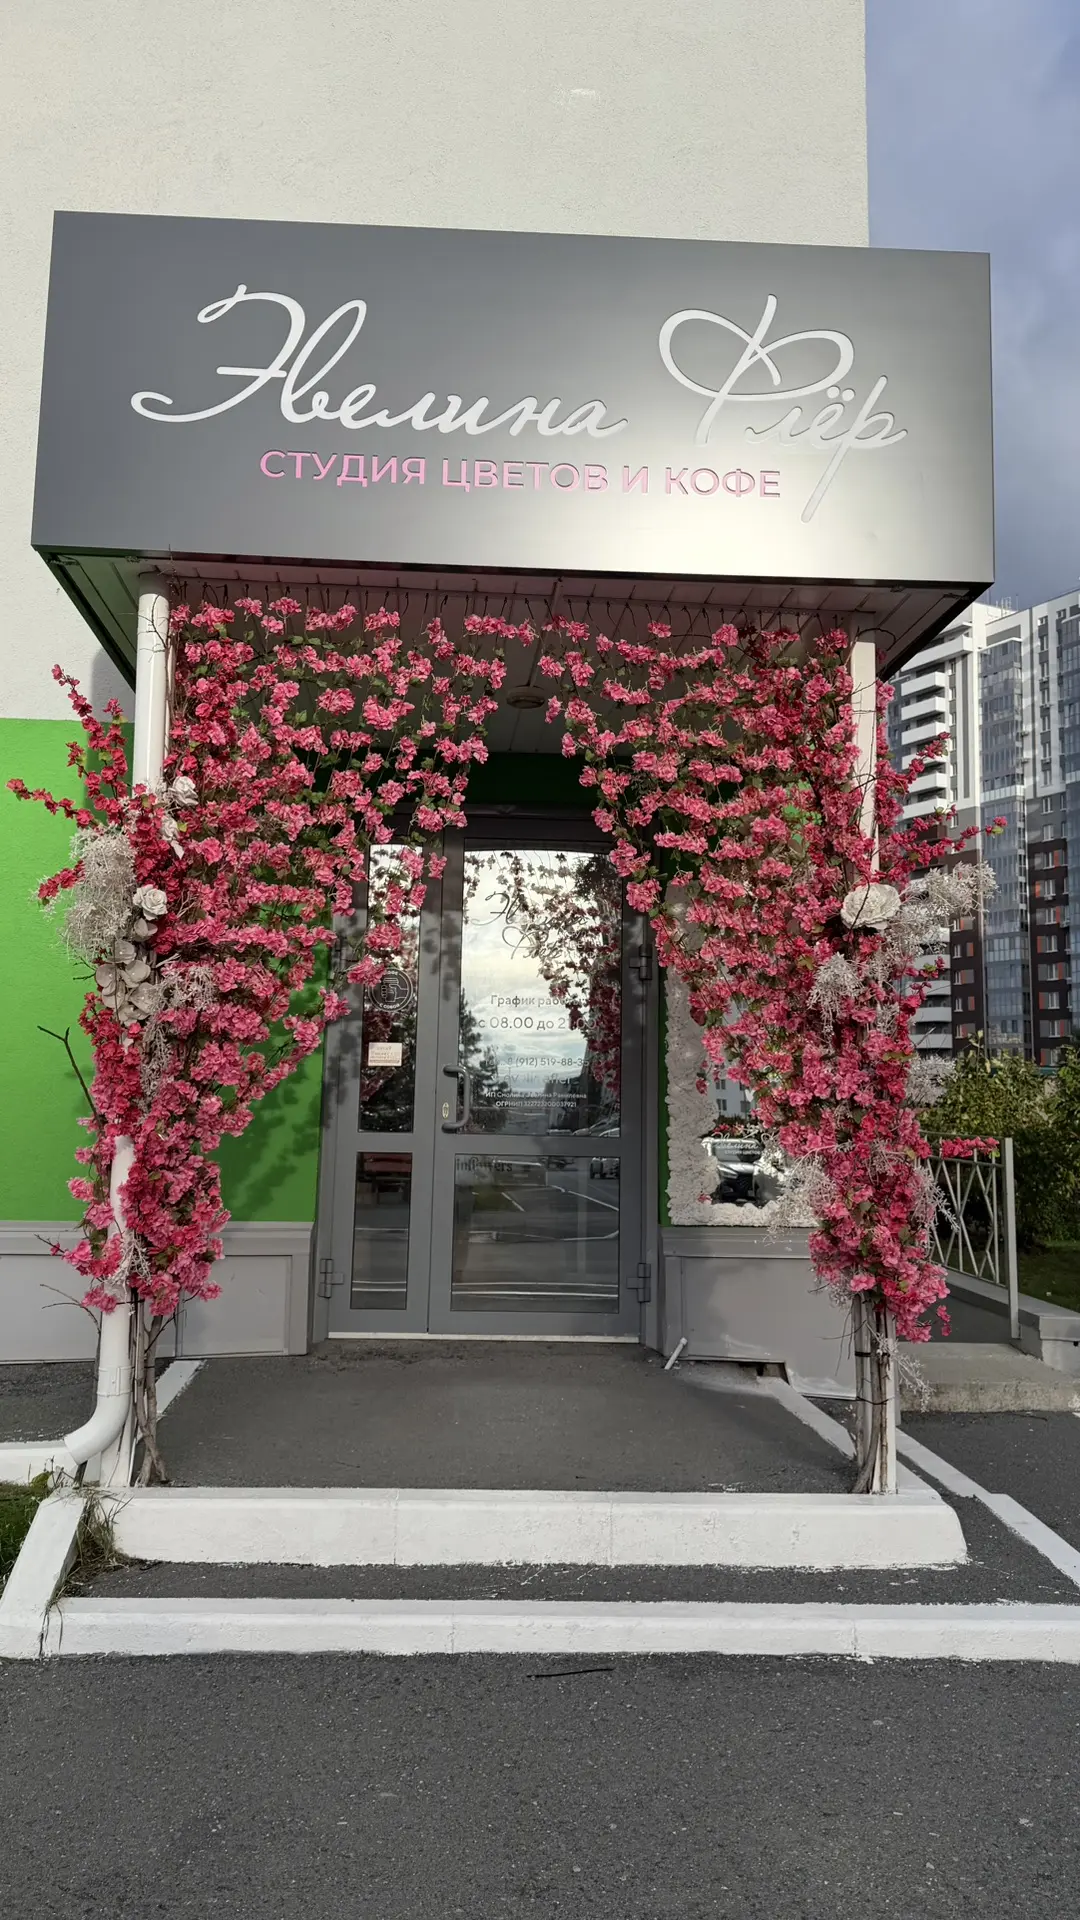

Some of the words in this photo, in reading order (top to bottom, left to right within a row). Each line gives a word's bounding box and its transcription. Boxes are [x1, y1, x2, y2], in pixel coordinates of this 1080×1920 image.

[131, 284, 629, 438] Эвелина
[658, 294, 909, 523] Флёр
[259, 449, 426, 487] СТУДИЯ
[441, 457, 609, 492] ЦВЕТОВ
[622, 465, 649, 494] И
[664, 467, 781, 498] КОФЕ
[490, 995, 535, 1008] График
[489, 1016, 534, 1029] 08.00
[536, 1020, 555, 1031] до
[516, 1057, 538, 1068] (912)
[540, 1057, 590, 1067] 519-88-35
